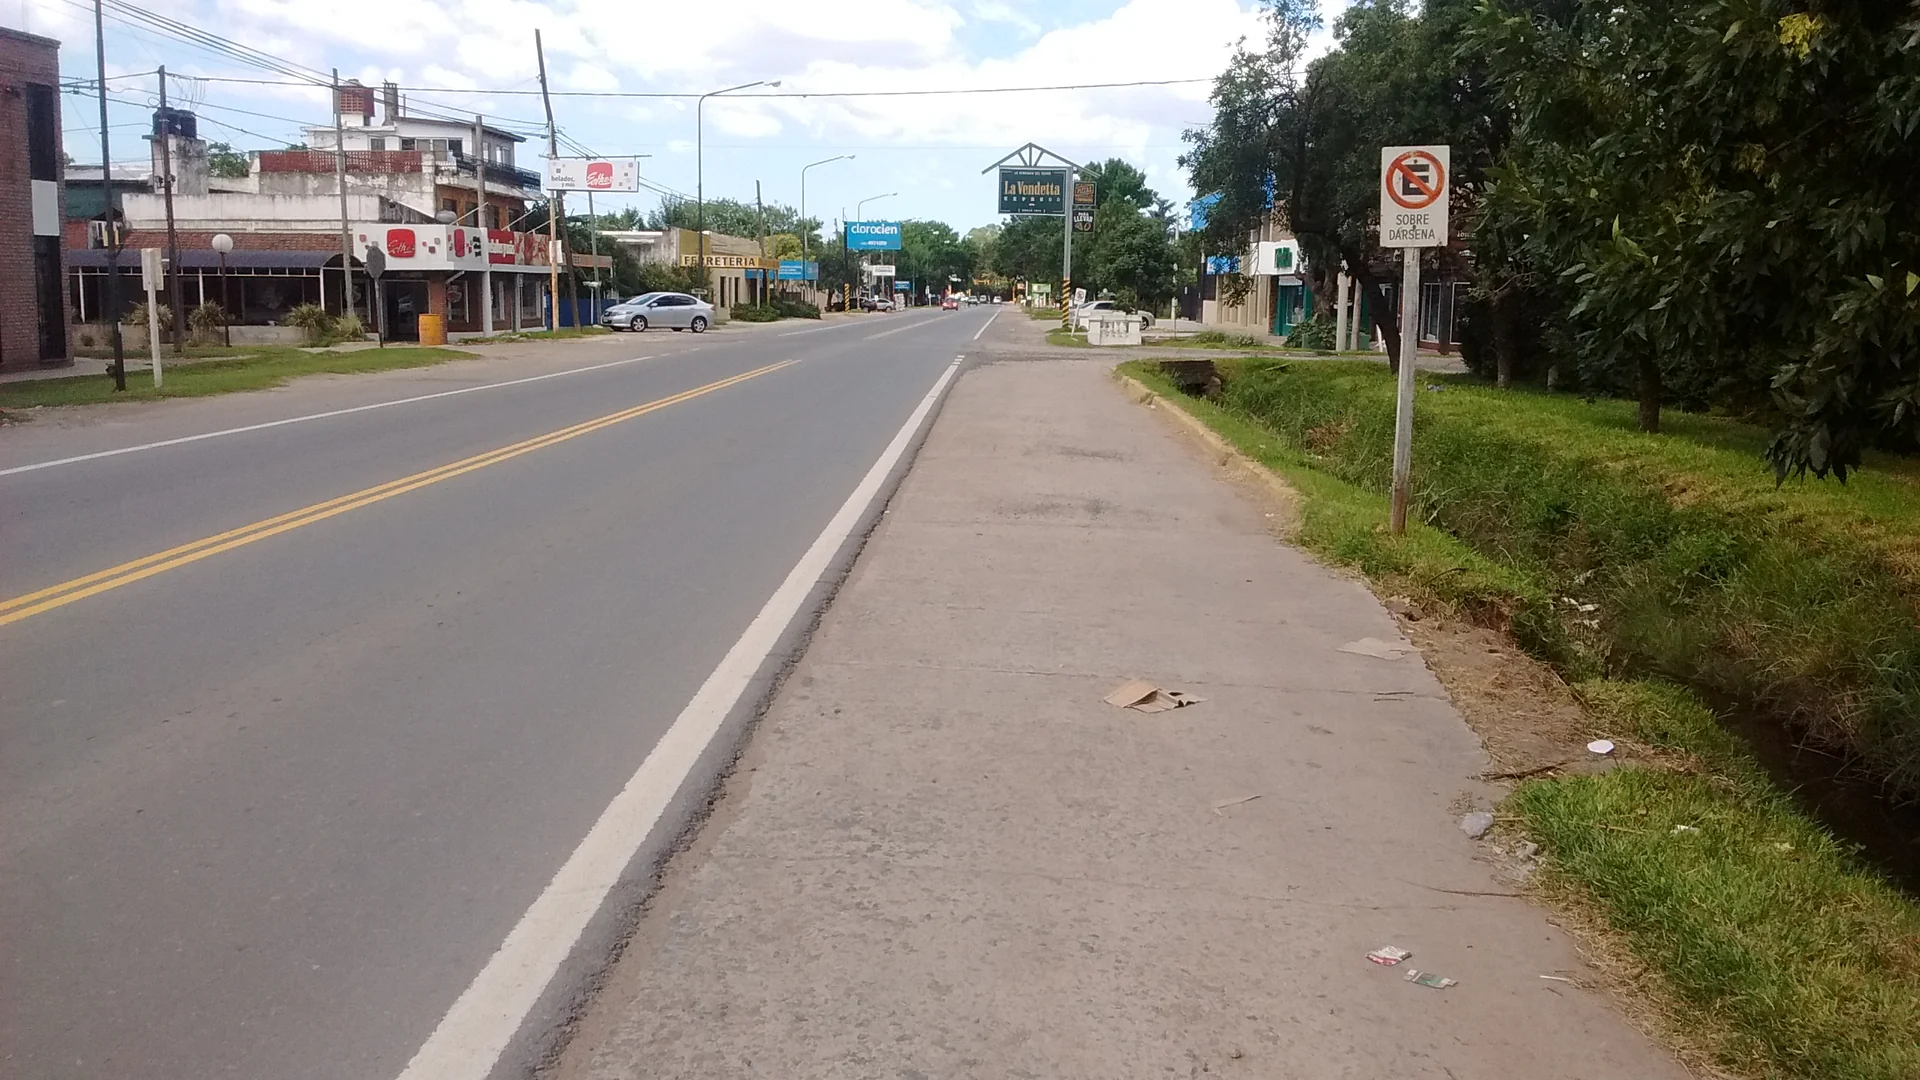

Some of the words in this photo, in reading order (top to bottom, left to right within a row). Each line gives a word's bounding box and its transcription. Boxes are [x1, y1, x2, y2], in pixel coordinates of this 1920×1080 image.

[1004, 180, 1016, 195] La
[1017, 180, 1060, 196] Vendetta
[1396, 214, 1430, 226] SOBRE
[850, 223, 898, 235] clorocien
[684, 256, 756, 267] FERETERIA
